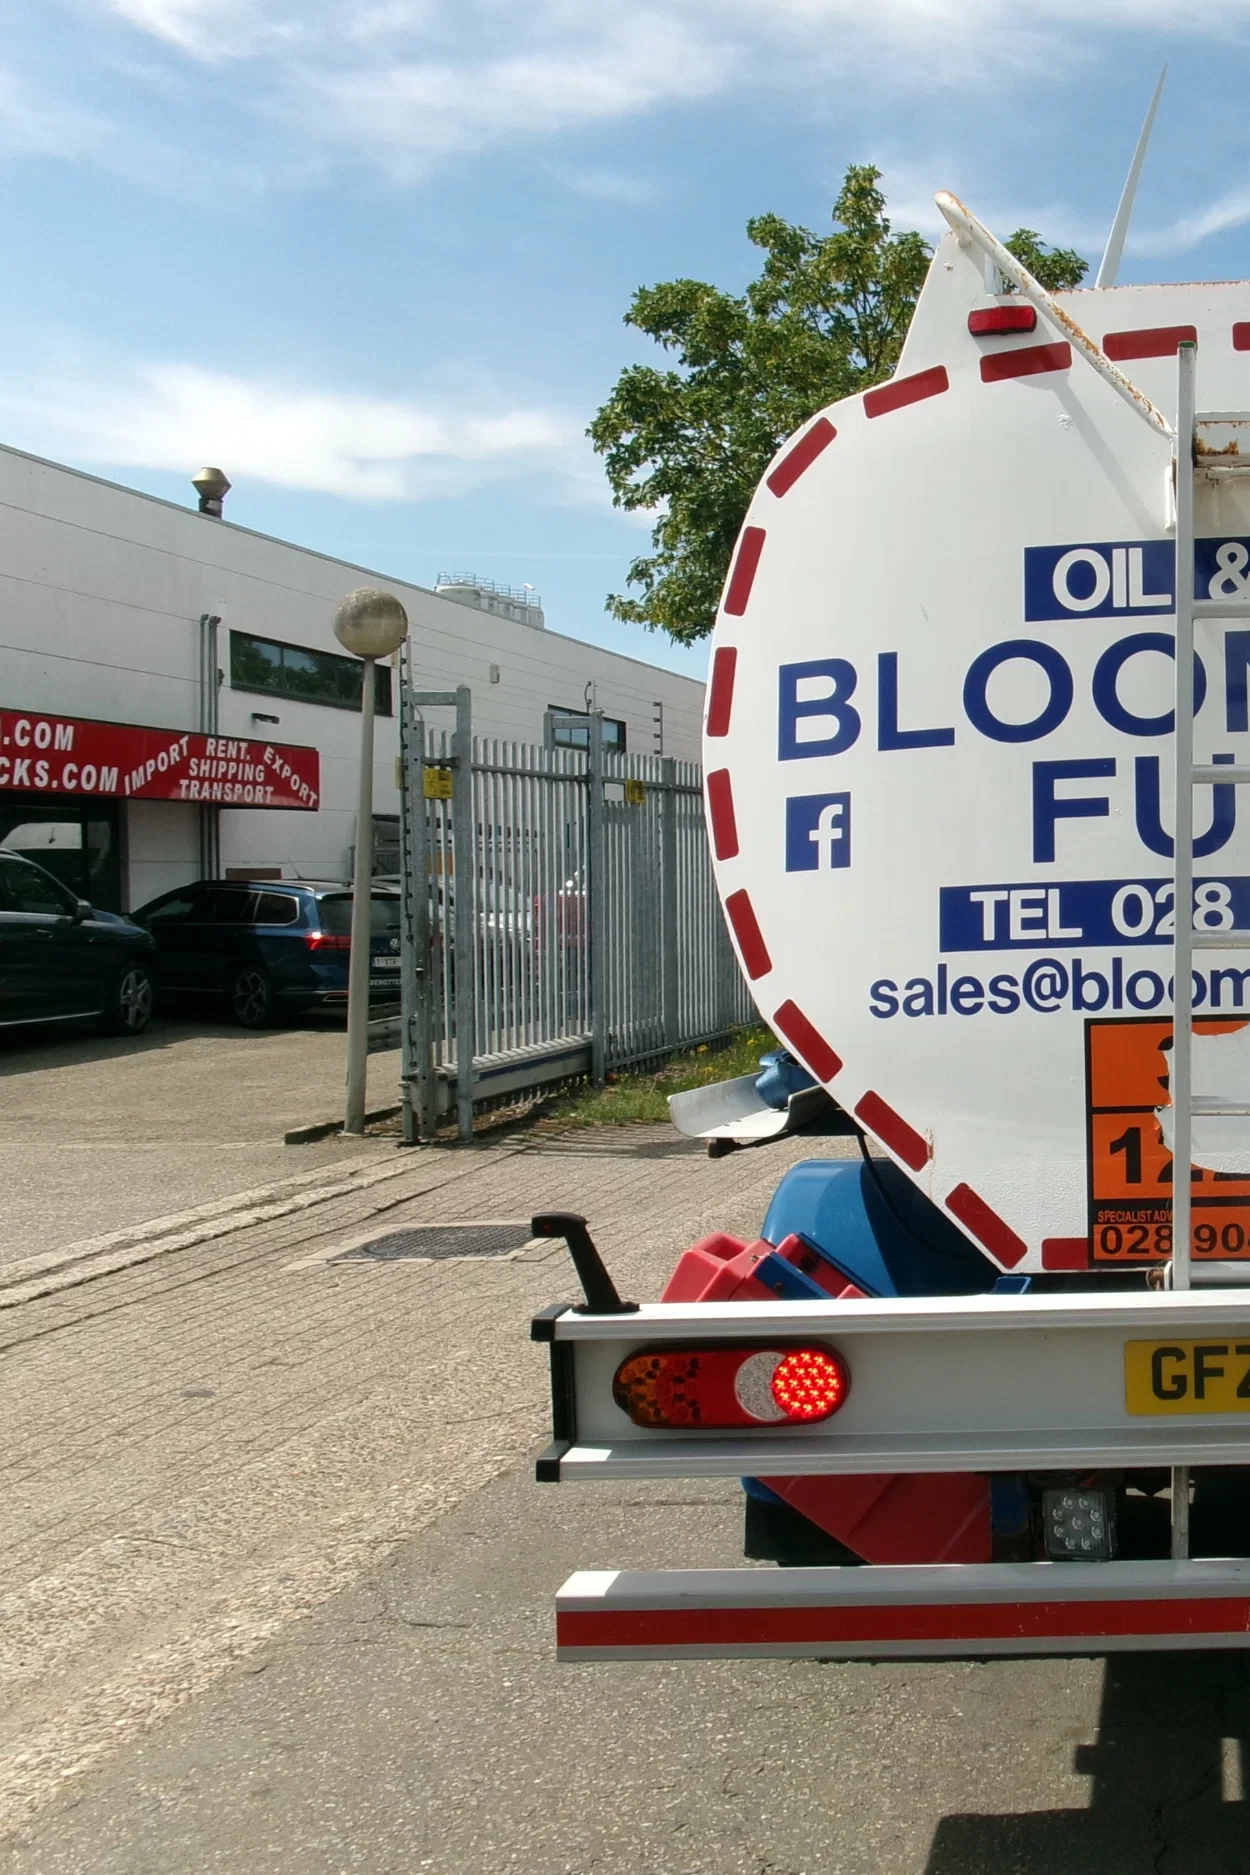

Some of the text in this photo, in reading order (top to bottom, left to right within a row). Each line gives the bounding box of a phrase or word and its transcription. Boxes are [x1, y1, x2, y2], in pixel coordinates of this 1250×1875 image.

[1052, 548, 1172, 612] OIL
[1, 719, 74, 751] .COM
[123, 735, 189, 796] IMPORT
[188, 758, 265, 782] SHIPPING
[264, 746, 318, 807] EXPORT
[179, 779, 274, 803] TRANSPORT
[969, 887, 1083, 941] TEL
[1098, 1210, 1174, 1222] SPECIALIST ADV
[1100, 1225, 1173, 1255] 028
